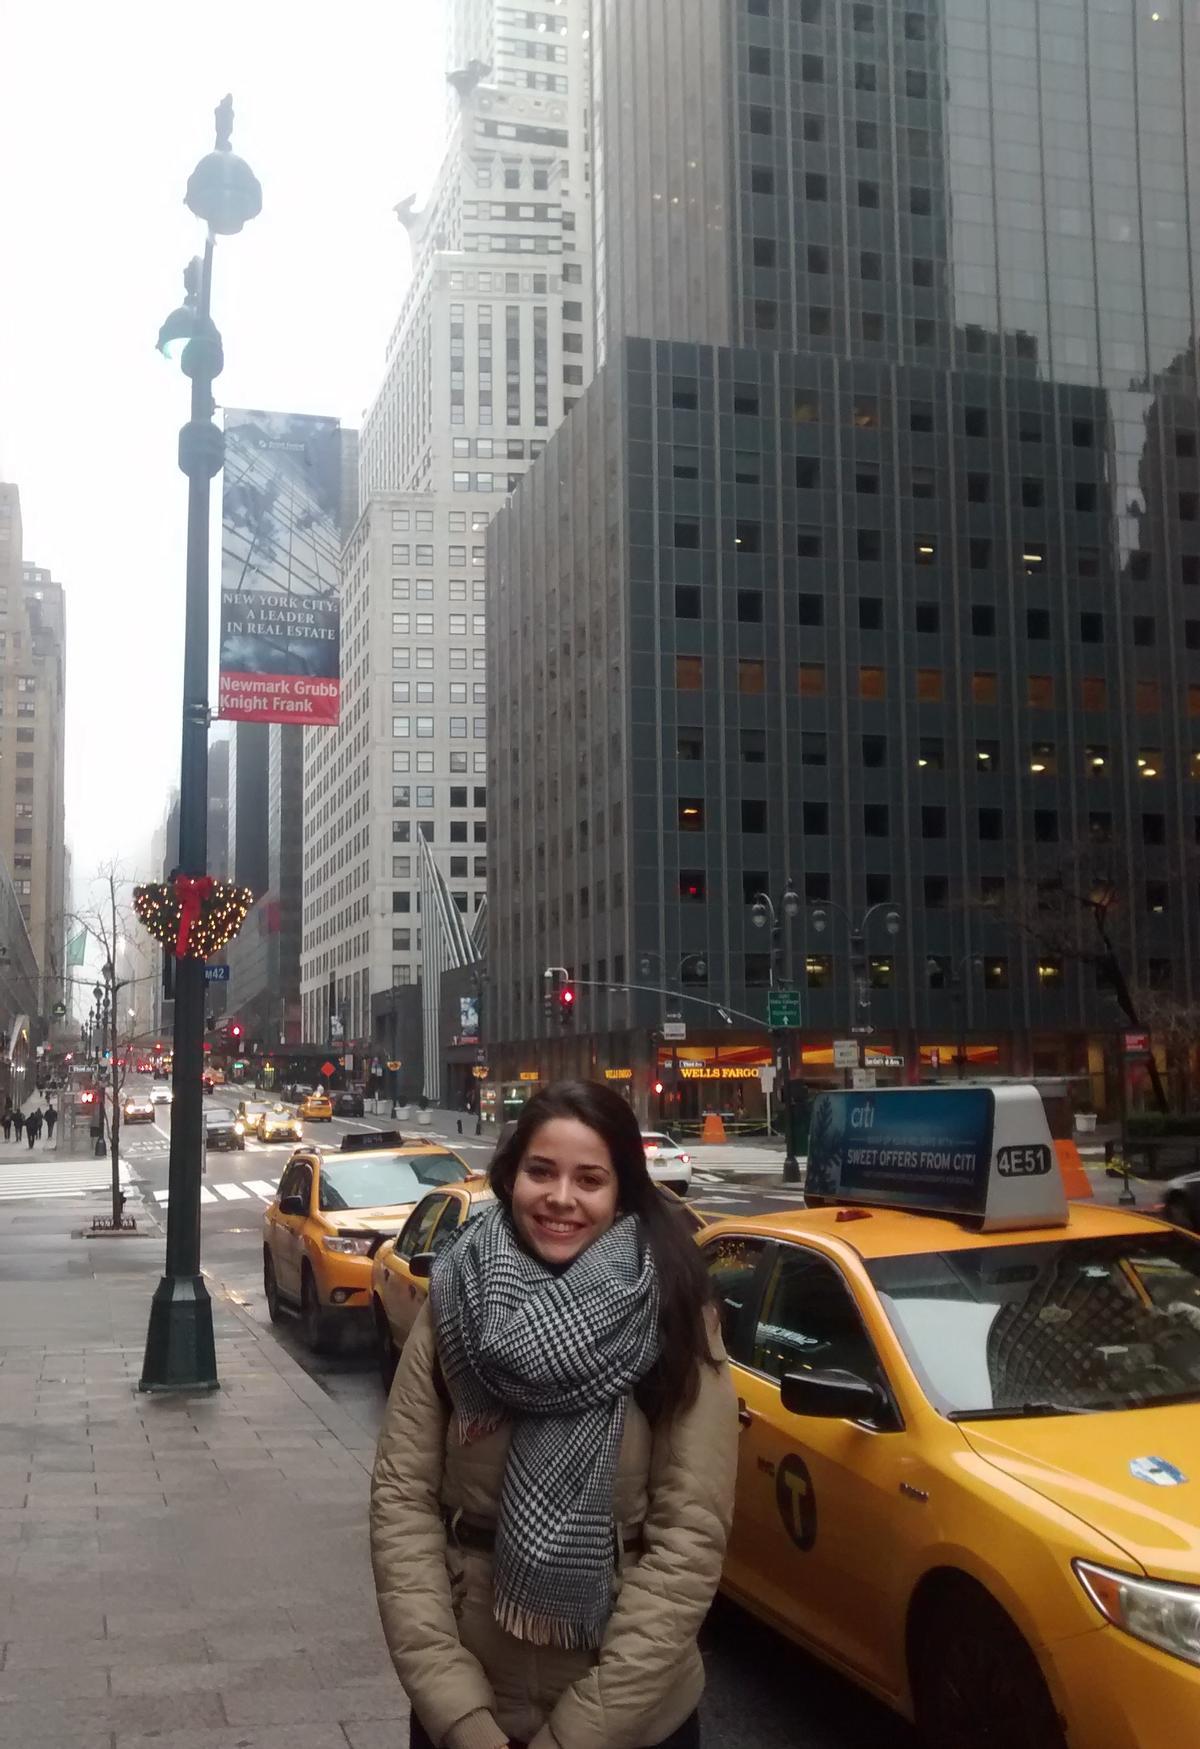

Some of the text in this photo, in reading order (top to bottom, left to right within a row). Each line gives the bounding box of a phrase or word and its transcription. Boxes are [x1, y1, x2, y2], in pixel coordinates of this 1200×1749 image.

[223, 593, 338, 612] NEW YORK CITY:
[247, 609, 315, 624] A LEADER
[227, 622, 335, 640] IN REAL ESTATE
[220, 677, 338, 697] Newmark Grubb
[220, 694, 313, 712] Knight Frank
[205, 967, 225, 979] M42
[681, 1068, 759, 1078] WELLS FARGO
[851, 1101, 875, 1128] citi
[847, 1149, 977, 1171] SWEET OFFERS FROM CITI
[998, 1150, 1045, 1172] 4E51
[784, 1471, 807, 1538] T
